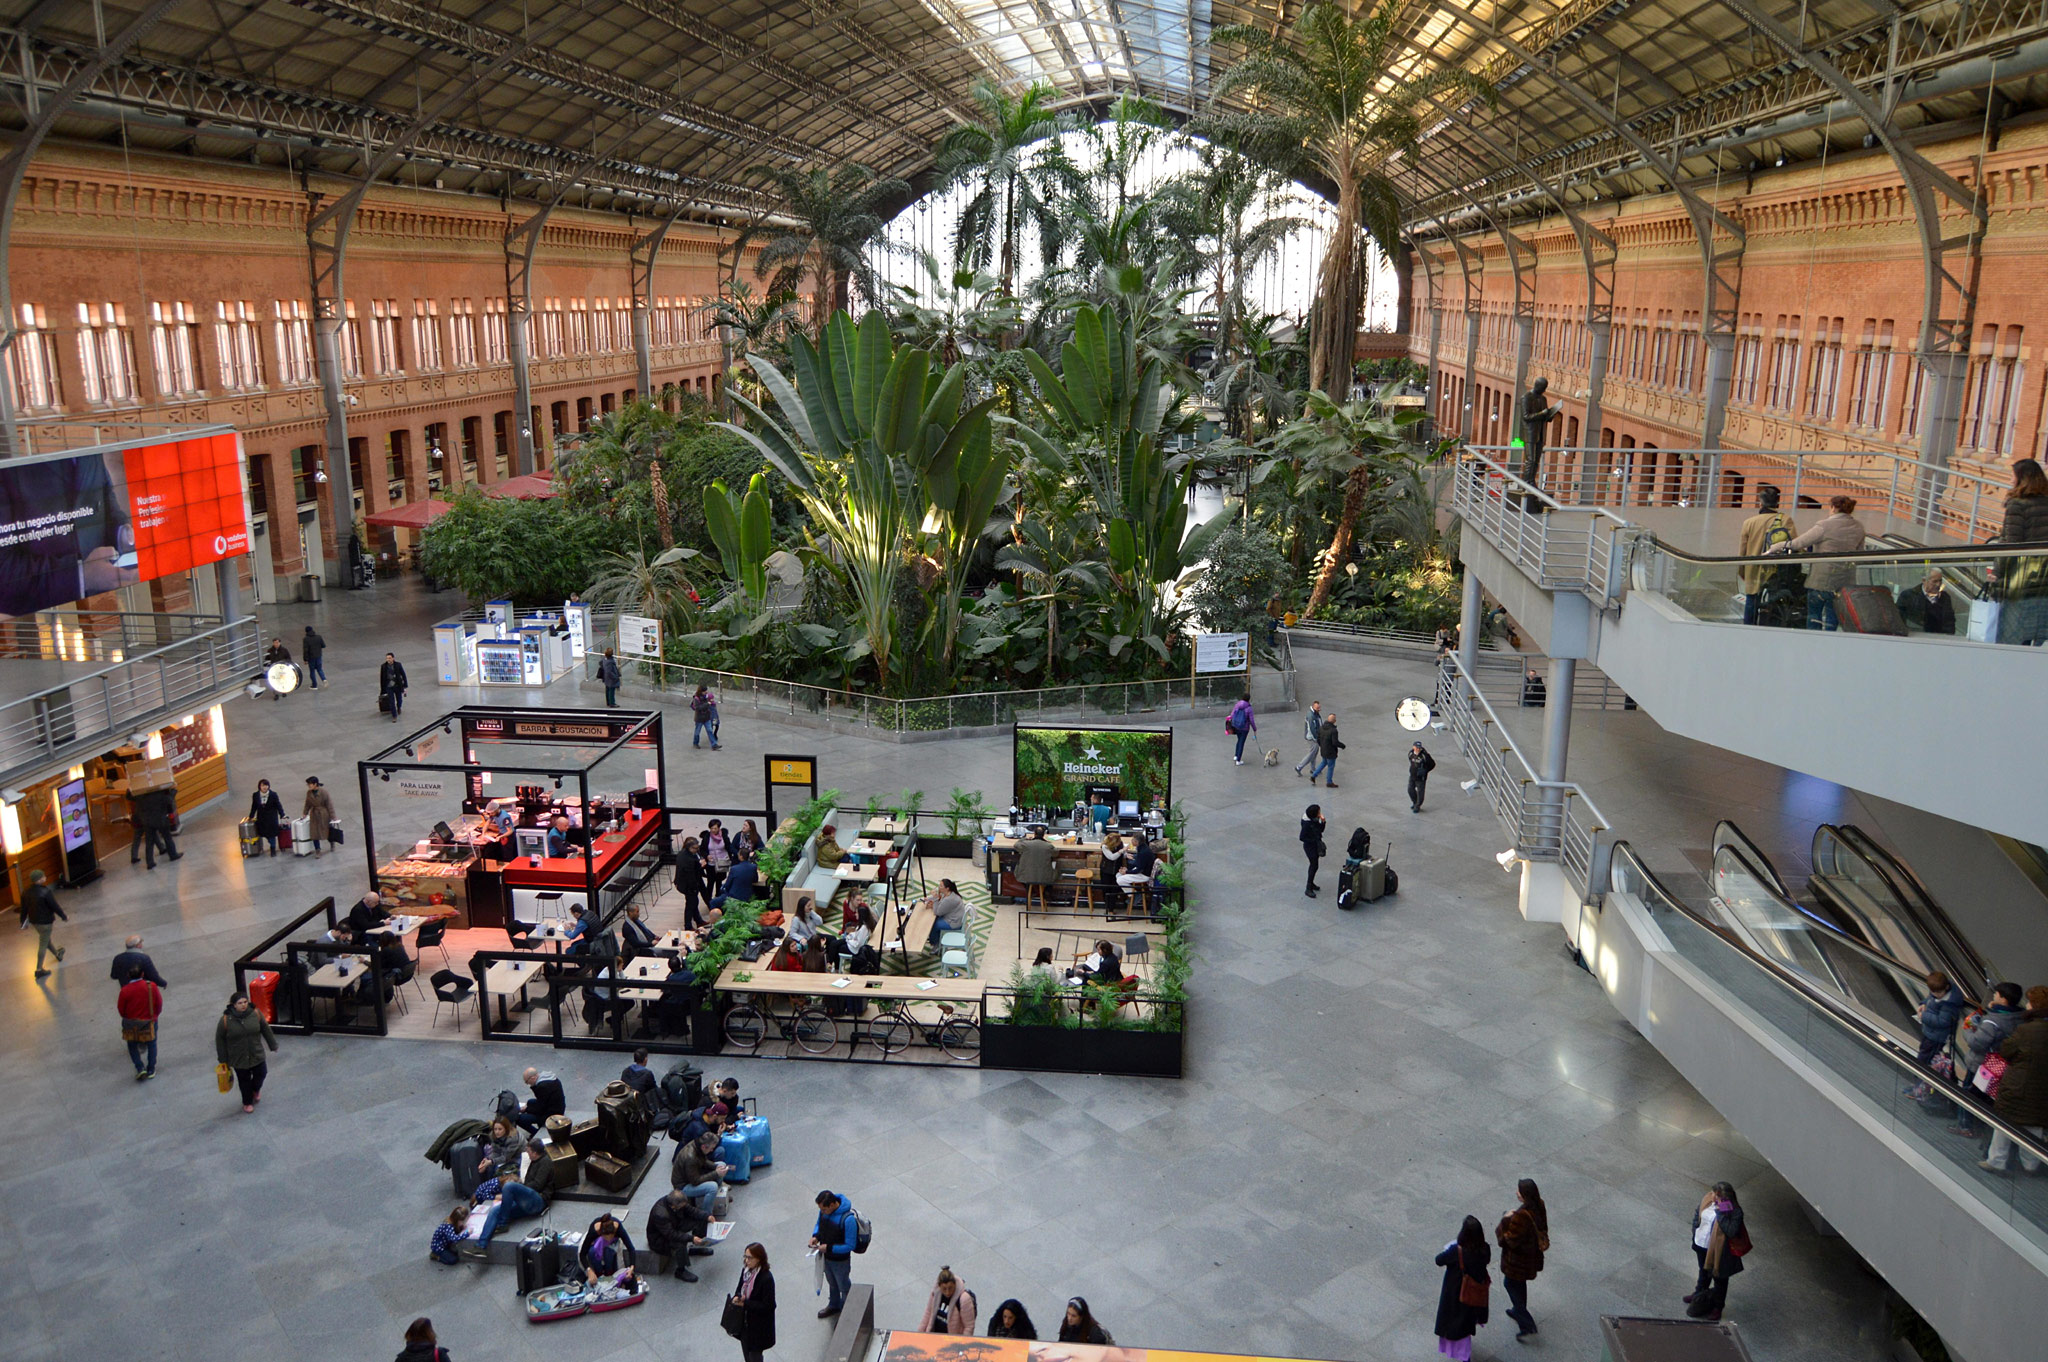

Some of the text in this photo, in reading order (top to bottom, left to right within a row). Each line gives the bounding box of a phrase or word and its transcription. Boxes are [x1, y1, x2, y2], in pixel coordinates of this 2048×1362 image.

[17, 520, 26, 529] tu
[27, 514, 56, 528] negocio
[57, 506, 94, 521] disponible
[19, 527, 54, 541] cualquier
[55, 523, 74, 536] lugar
[227, 533, 247, 542] vodafone
[1064, 762, 1121, 774] Heineken
